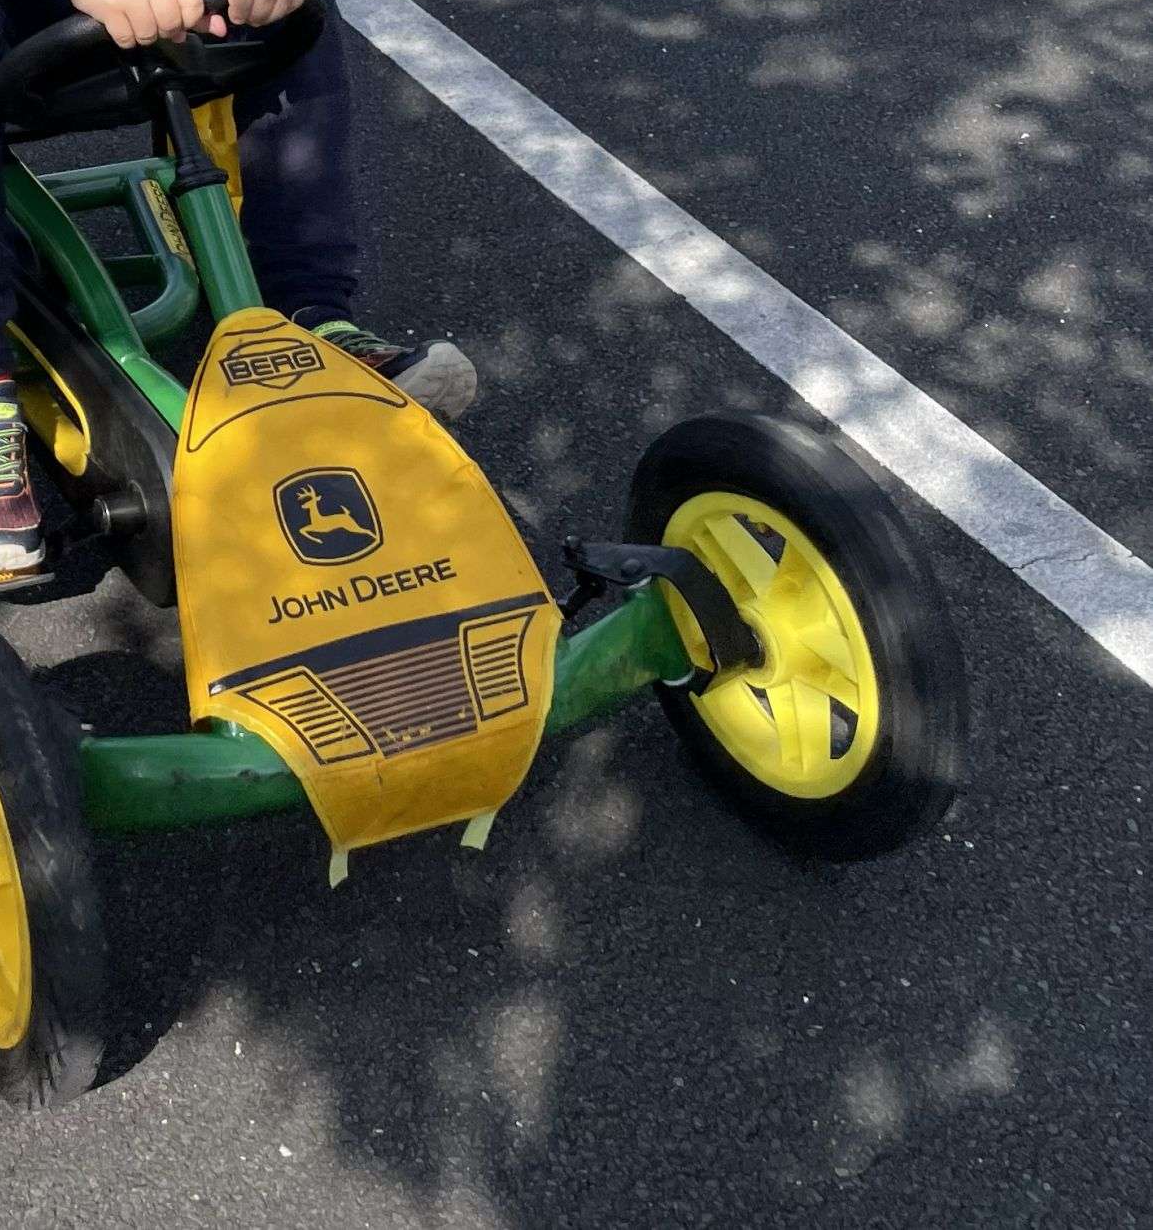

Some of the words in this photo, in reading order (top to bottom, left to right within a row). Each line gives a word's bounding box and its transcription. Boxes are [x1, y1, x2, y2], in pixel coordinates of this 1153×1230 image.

[226, 348, 318, 380] BERG
[268, 585, 349, 624] JOHN
[350, 557, 457, 603] DEERE
